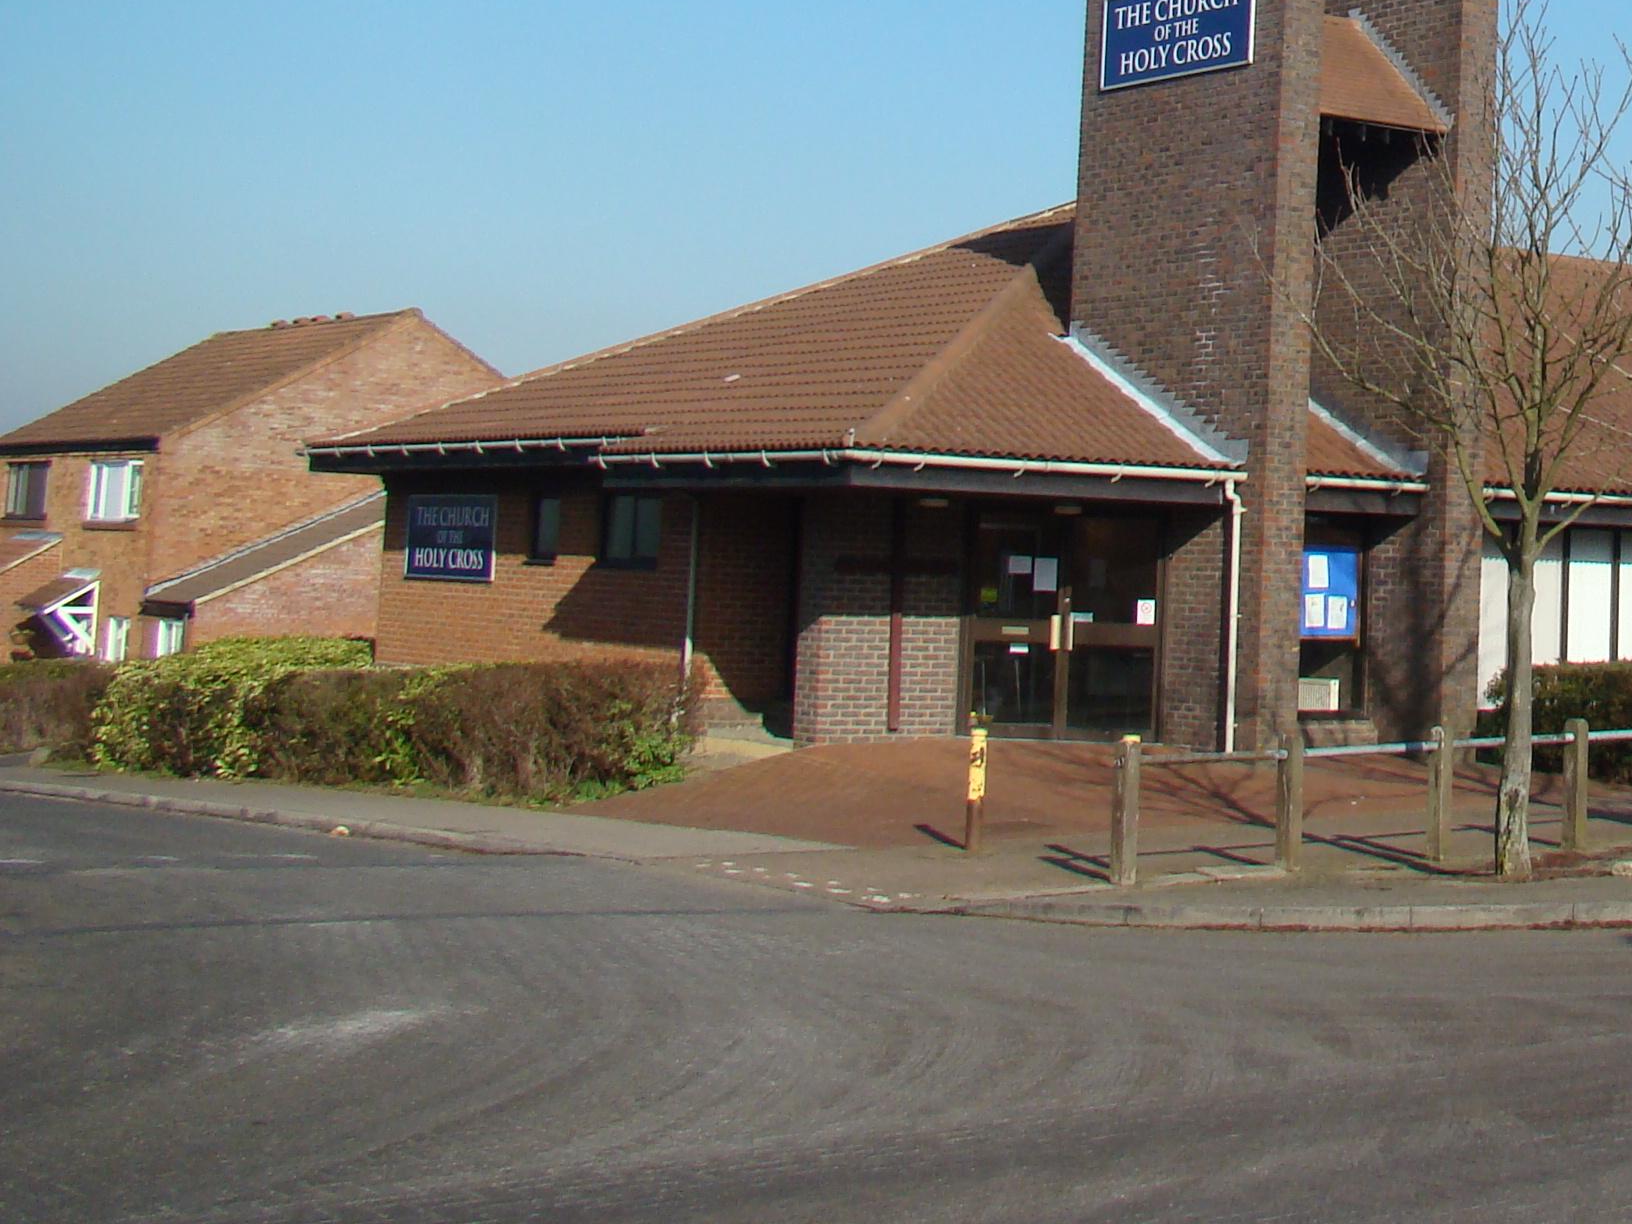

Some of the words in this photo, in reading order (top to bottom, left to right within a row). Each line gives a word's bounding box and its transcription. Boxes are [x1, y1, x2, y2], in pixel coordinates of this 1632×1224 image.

[1115, 2, 1151, 30] THE
[1154, 23, 1171, 42] OF
[1174, 18, 1199, 38] THE
[1119, 43, 1171, 76] HOLY
[1173, 32, 1232, 65] CROSS
[417, 506, 439, 527] THE
[440, 506, 490, 527] CHURCH
[415, 547, 447, 568] HOLY
[448, 548, 484, 570] CROSS
